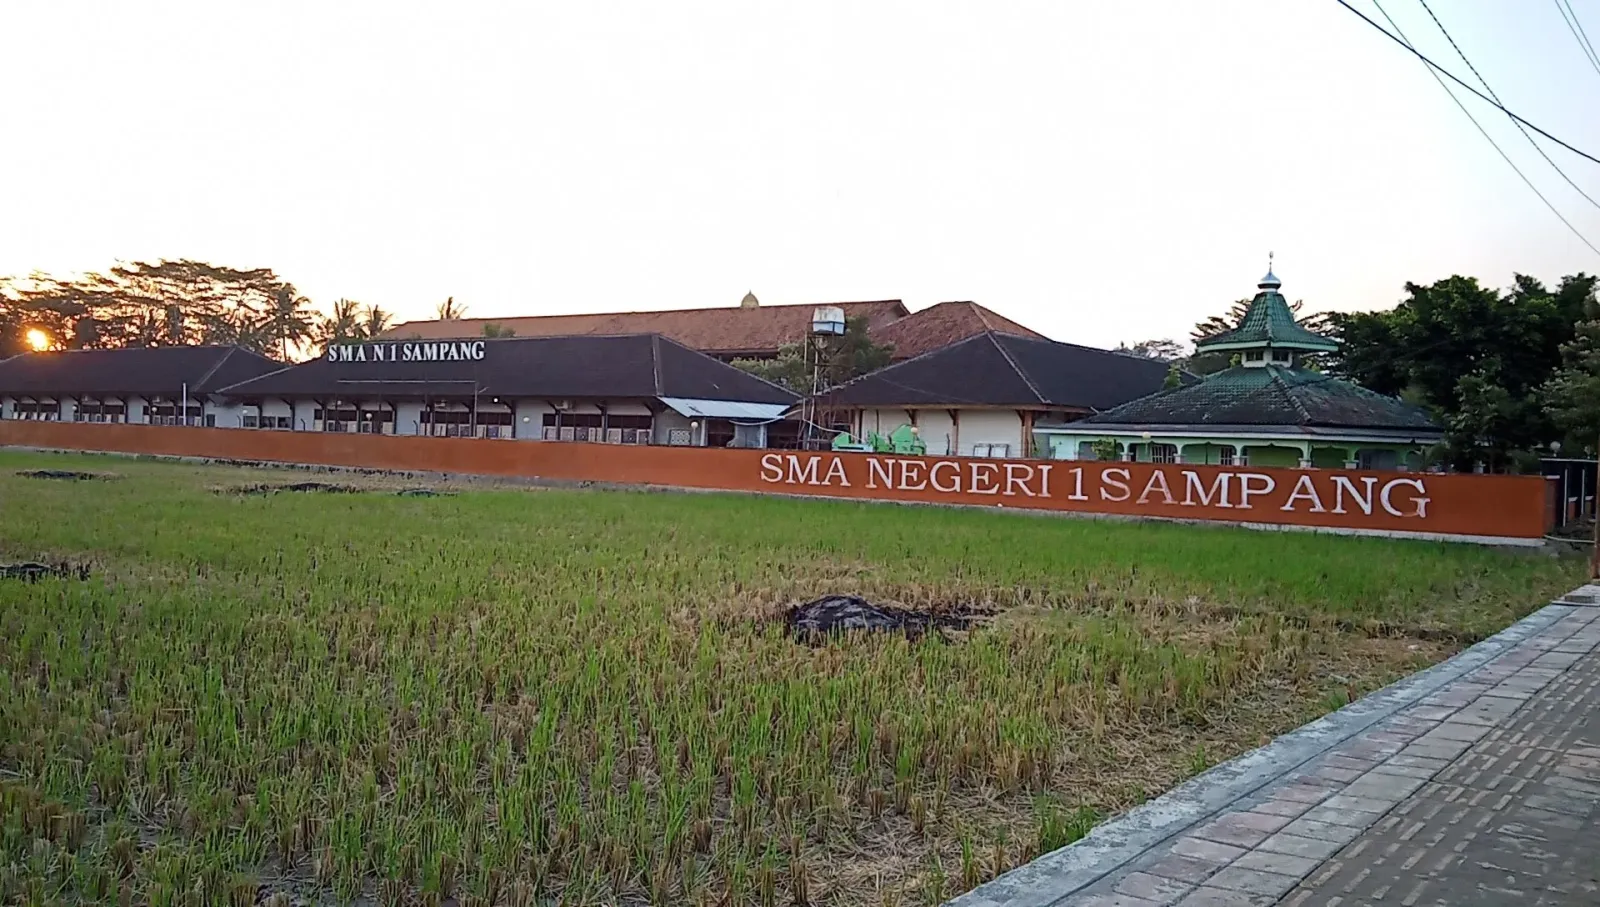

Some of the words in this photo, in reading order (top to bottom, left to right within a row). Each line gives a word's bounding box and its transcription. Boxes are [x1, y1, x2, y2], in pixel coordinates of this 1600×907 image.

[328, 343, 367, 362] SMA
[372, 343, 385, 362] N
[390, 343, 397, 362] 1
[402, 341, 485, 362] SAMPANG
[760, 453, 851, 487] SMA
[865, 458, 1053, 498] NEGERI
[1067, 467, 1089, 501] 1
[1099, 467, 1431, 519] SAMPANG
